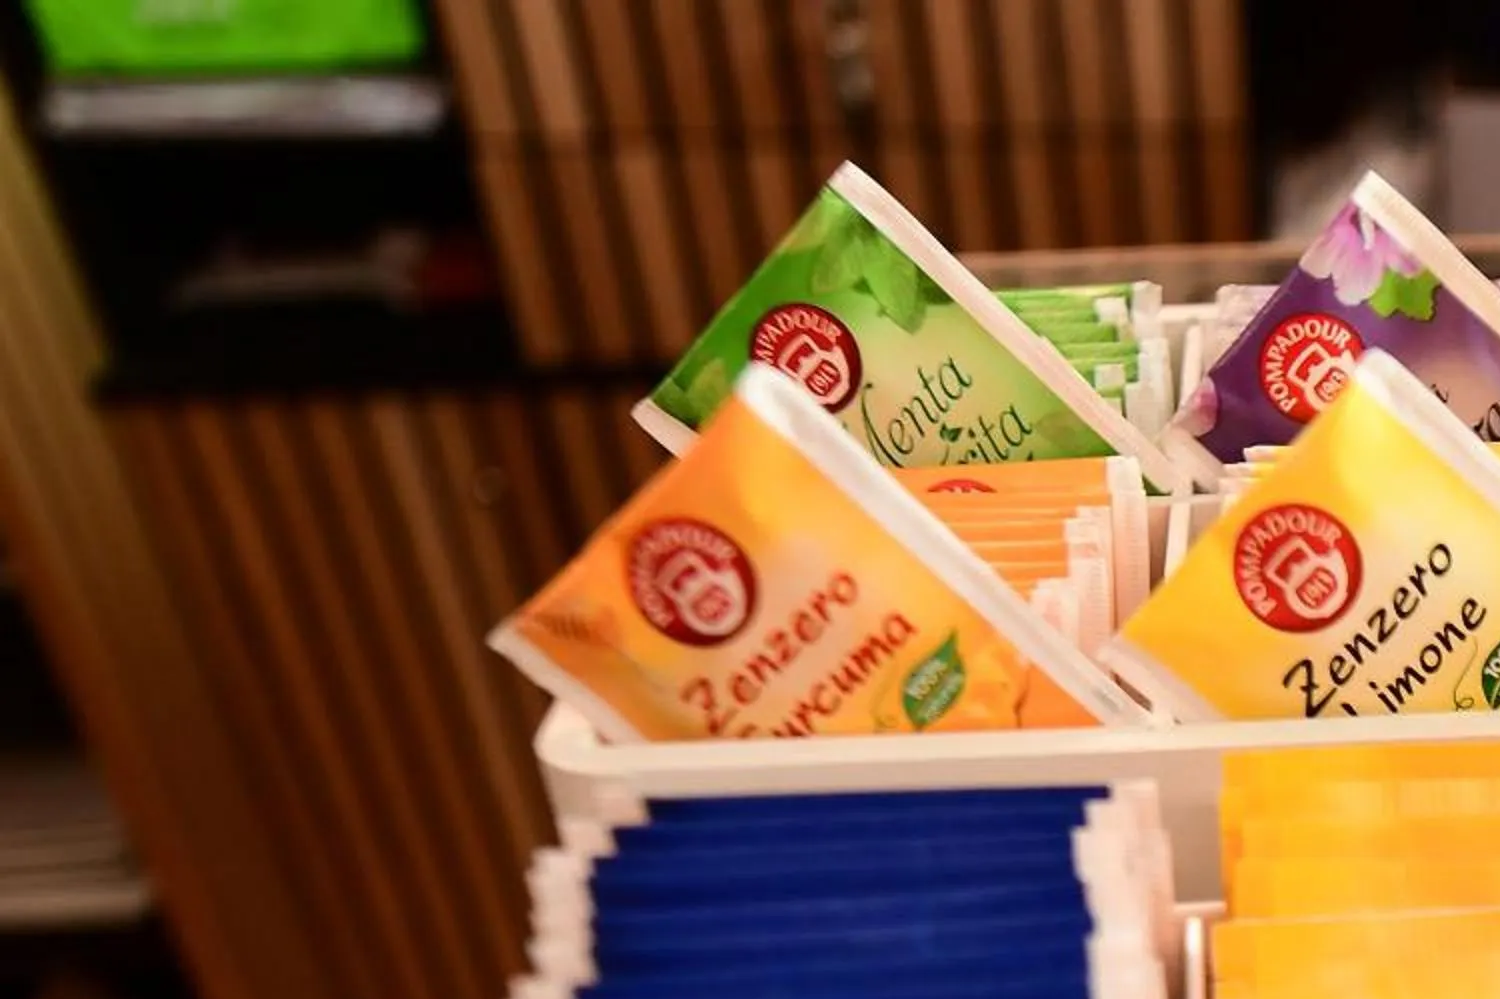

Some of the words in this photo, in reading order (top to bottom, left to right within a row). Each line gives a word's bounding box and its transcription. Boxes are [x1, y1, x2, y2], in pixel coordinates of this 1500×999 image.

[754, 308, 842, 367] MPADOUR
[1265, 319, 1352, 413] POMPADOUR
[1238, 508, 1343, 617] POMPADOUR
[678, 571, 858, 736] Zenzero
[736, 612, 917, 738] urcuma
[1282, 543, 1453, 719] Zenzero
[1340, 597, 1488, 718] imone
